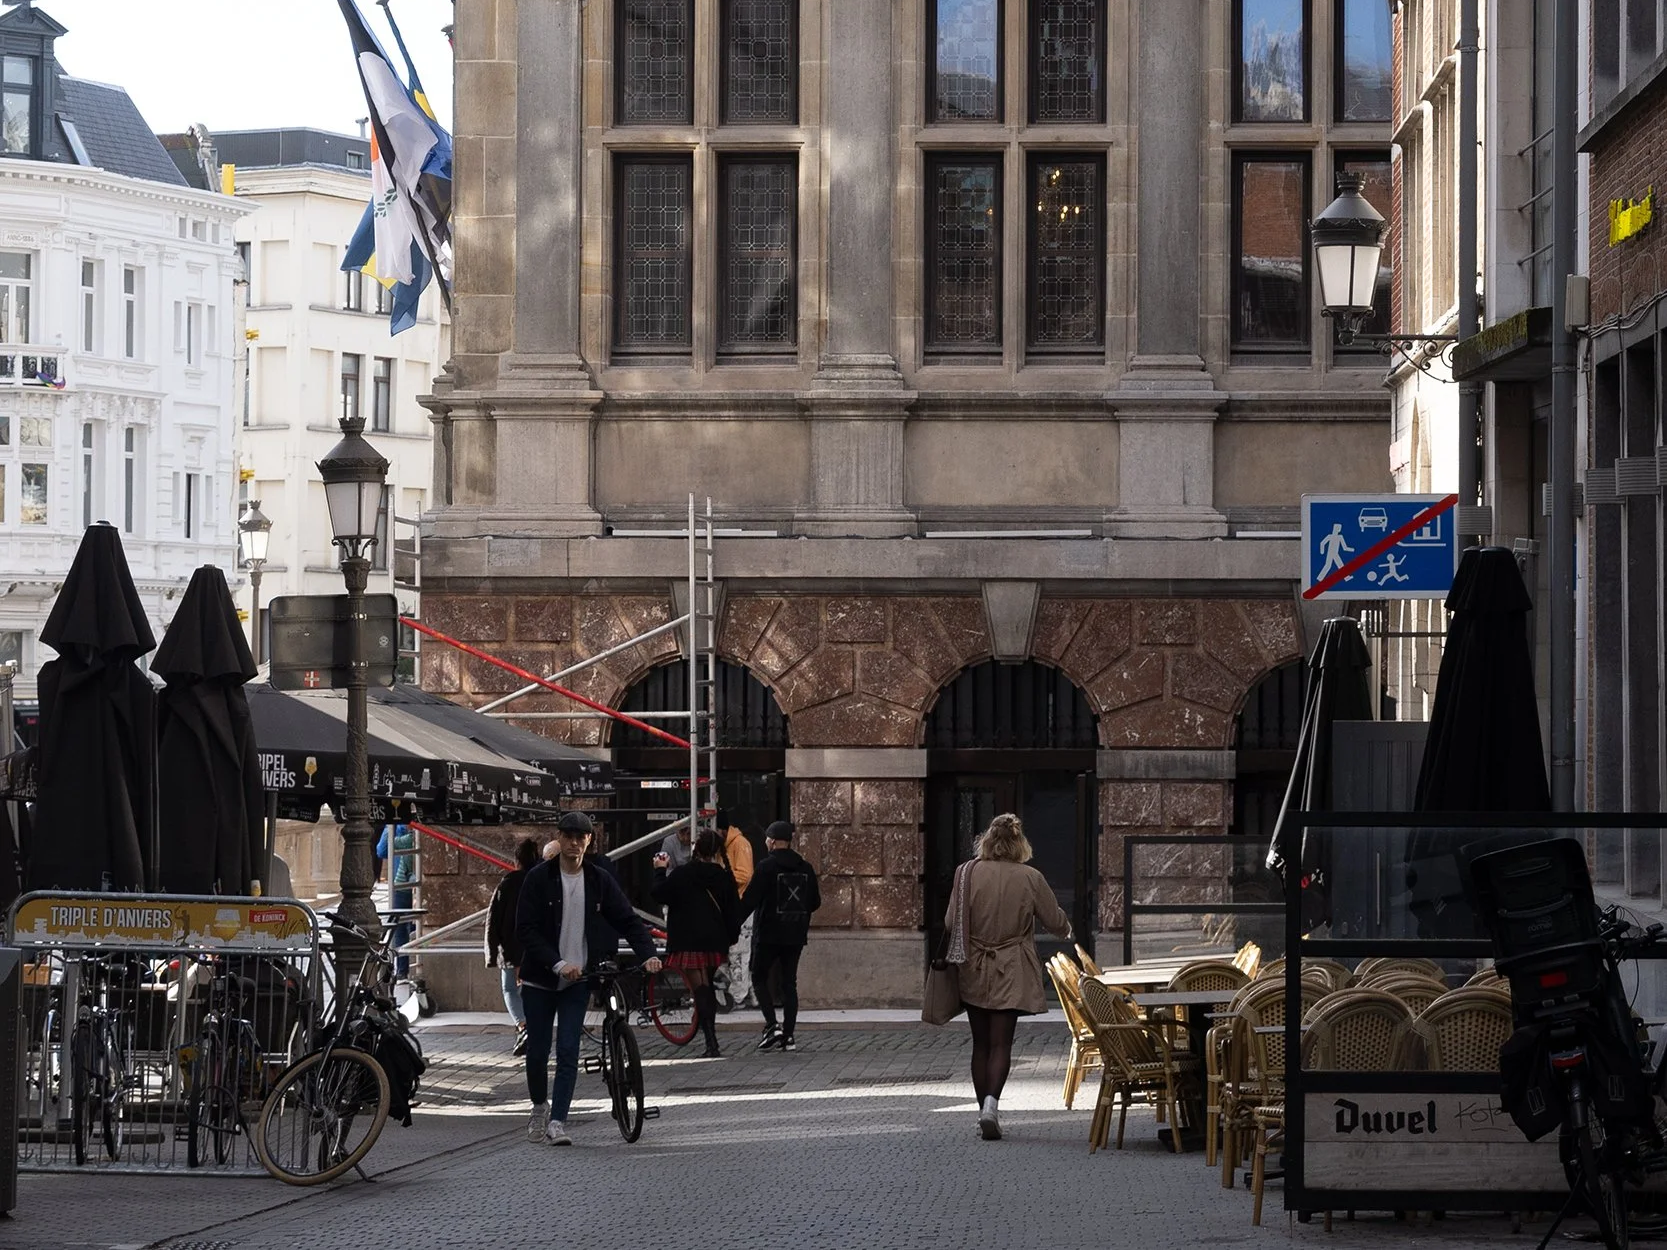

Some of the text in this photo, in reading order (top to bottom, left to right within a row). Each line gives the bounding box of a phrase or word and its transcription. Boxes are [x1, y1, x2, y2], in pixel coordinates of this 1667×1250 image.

[51, 906, 172, 929] TRIPLE D'ANVERS
[1334, 1098, 1437, 1134] Duvel
